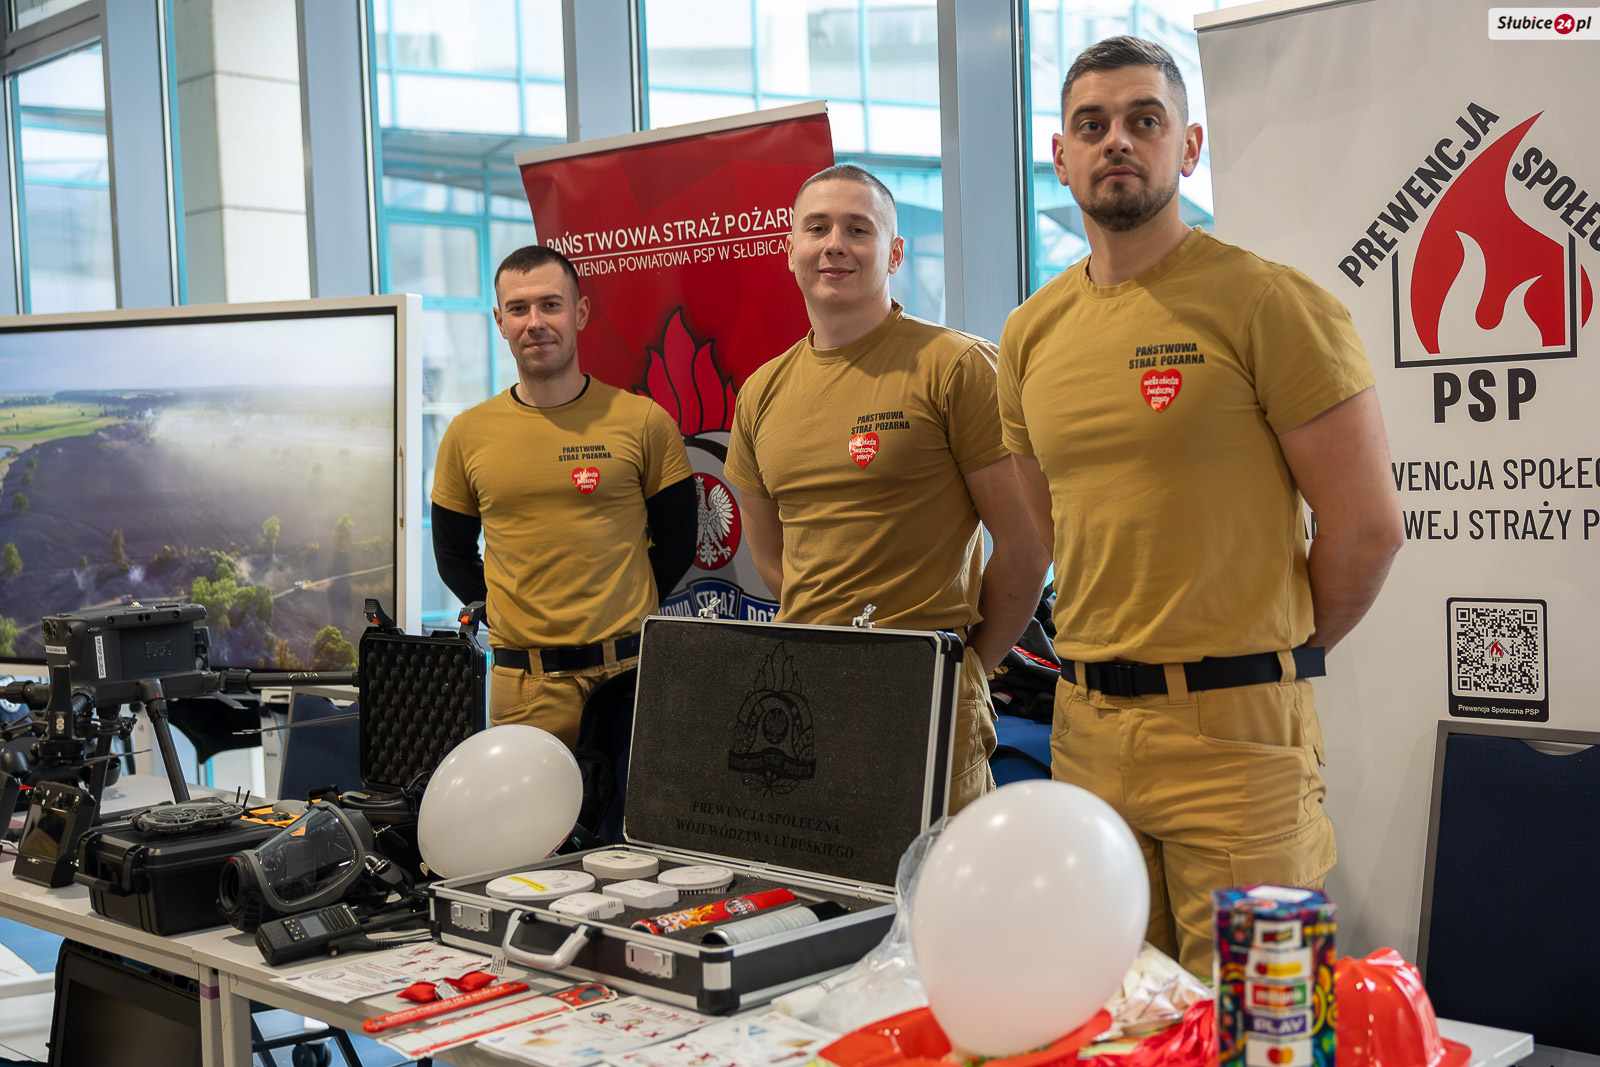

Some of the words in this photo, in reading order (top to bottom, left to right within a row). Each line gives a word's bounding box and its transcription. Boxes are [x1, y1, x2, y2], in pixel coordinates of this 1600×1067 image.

[1337, 102, 1500, 288] PREWENCJA
[662, 212, 722, 242] STRAŻ
[725, 206, 795, 234] POŻARN
[573, 260, 617, 277] MENDA
[619, 252, 692, 273] POWIATOWA
[694, 247, 715, 263] PSP
[717, 245, 730, 260] W
[733, 239, 787, 259] SŁUBICA
[1136, 343, 1198, 357] PAŃSTWOWA
[1433, 367, 1537, 423] PSP
[857, 411, 904, 424] PAŃSTWOWA
[1391, 459, 1494, 491] WENCJA
[1469, 500, 1572, 540] STRAŻY
[1458, 704, 1490, 714] Prewencja
[1524, 708, 1540, 716] PSP
[692, 800, 765, 822] PREWENCJA
[676, 818, 770, 845] WOJEWÓDZTWA
[773, 835, 854, 860] LUBUSKIEGO
